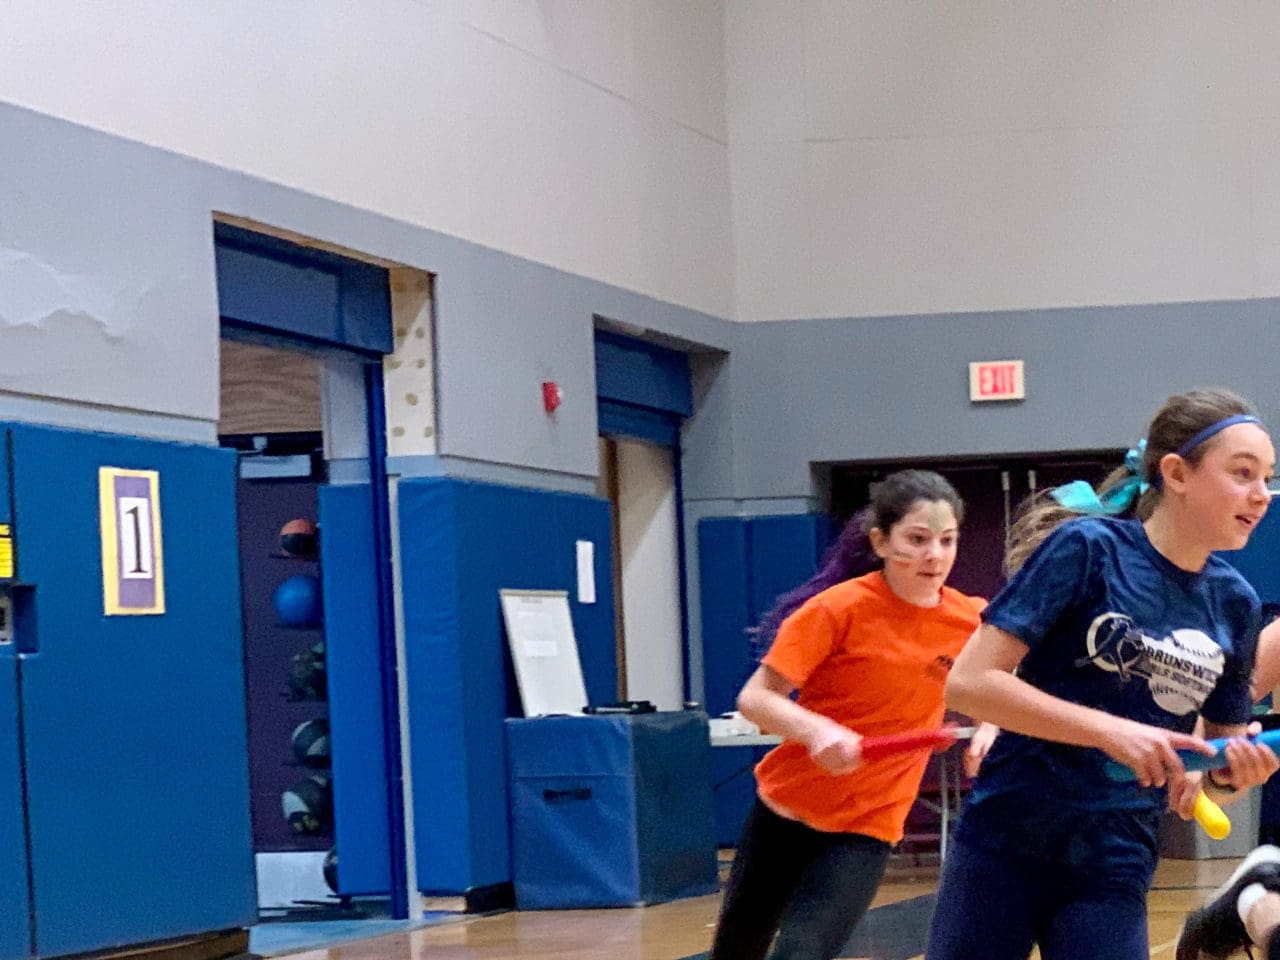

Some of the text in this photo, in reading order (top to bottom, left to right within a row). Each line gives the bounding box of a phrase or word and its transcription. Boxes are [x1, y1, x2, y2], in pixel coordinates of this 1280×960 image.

[978, 365, 1016, 395] EXIT
[125, 506, 149, 574] 1
[1145, 645, 1221, 684] BRUNSW
